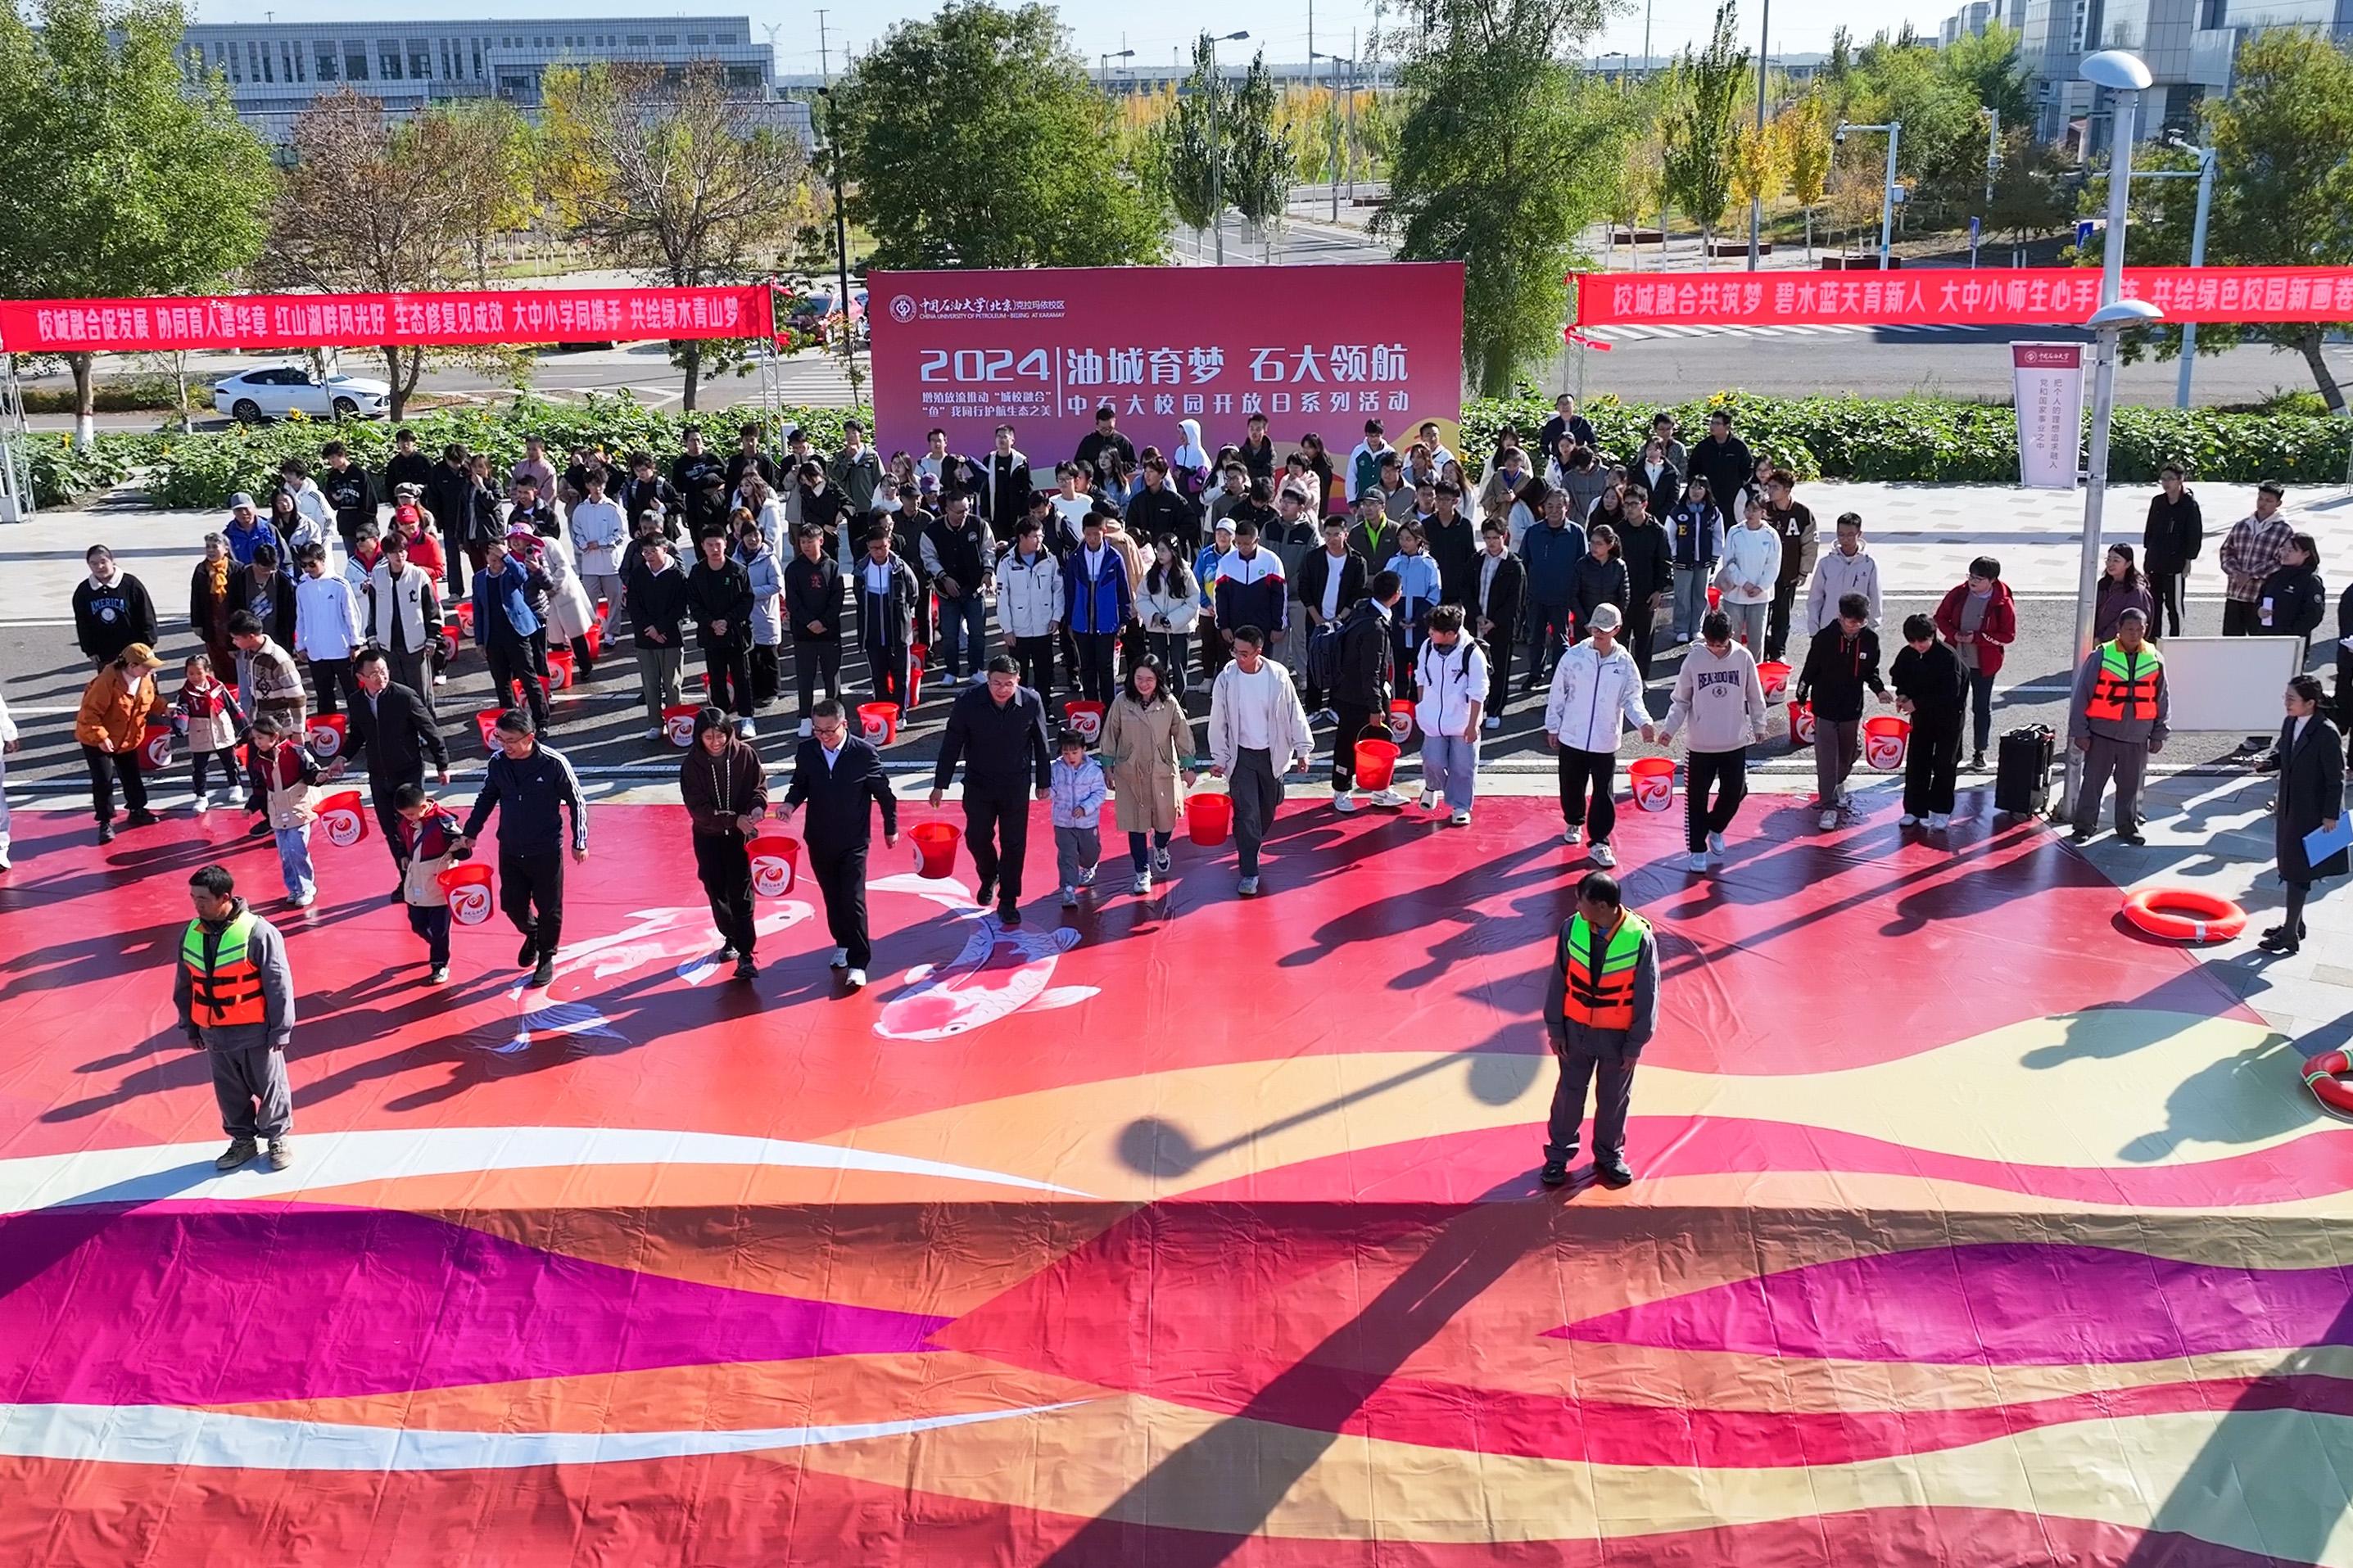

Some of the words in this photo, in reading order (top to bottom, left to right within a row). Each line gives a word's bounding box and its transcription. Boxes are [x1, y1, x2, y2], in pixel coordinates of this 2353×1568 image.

[1613, 281, 1763, 316] 校城融合共筑梦
[1775, 279, 1926, 315] 碧水蓝天育新人
[1938, 278, 2140, 313] 大中小师生心手连
[37, 307, 150, 341] 校城融合促发展
[156, 304, 269, 339] 协同育人谱华章
[275, 302, 386, 337] 红山湖畔风光好
[395, 300, 505, 336] 生态修复见成效
[512, 298, 622, 333] 大中小学同携手
[630, 296, 739, 331] 共绘绿水青山梦
[920, 348, 1051, 382] 2024
[1066, 346, 1224, 385] 油城育梦
[1248, 343, 1409, 383] 石大领航
[1785, 517, 1801, 536] A
